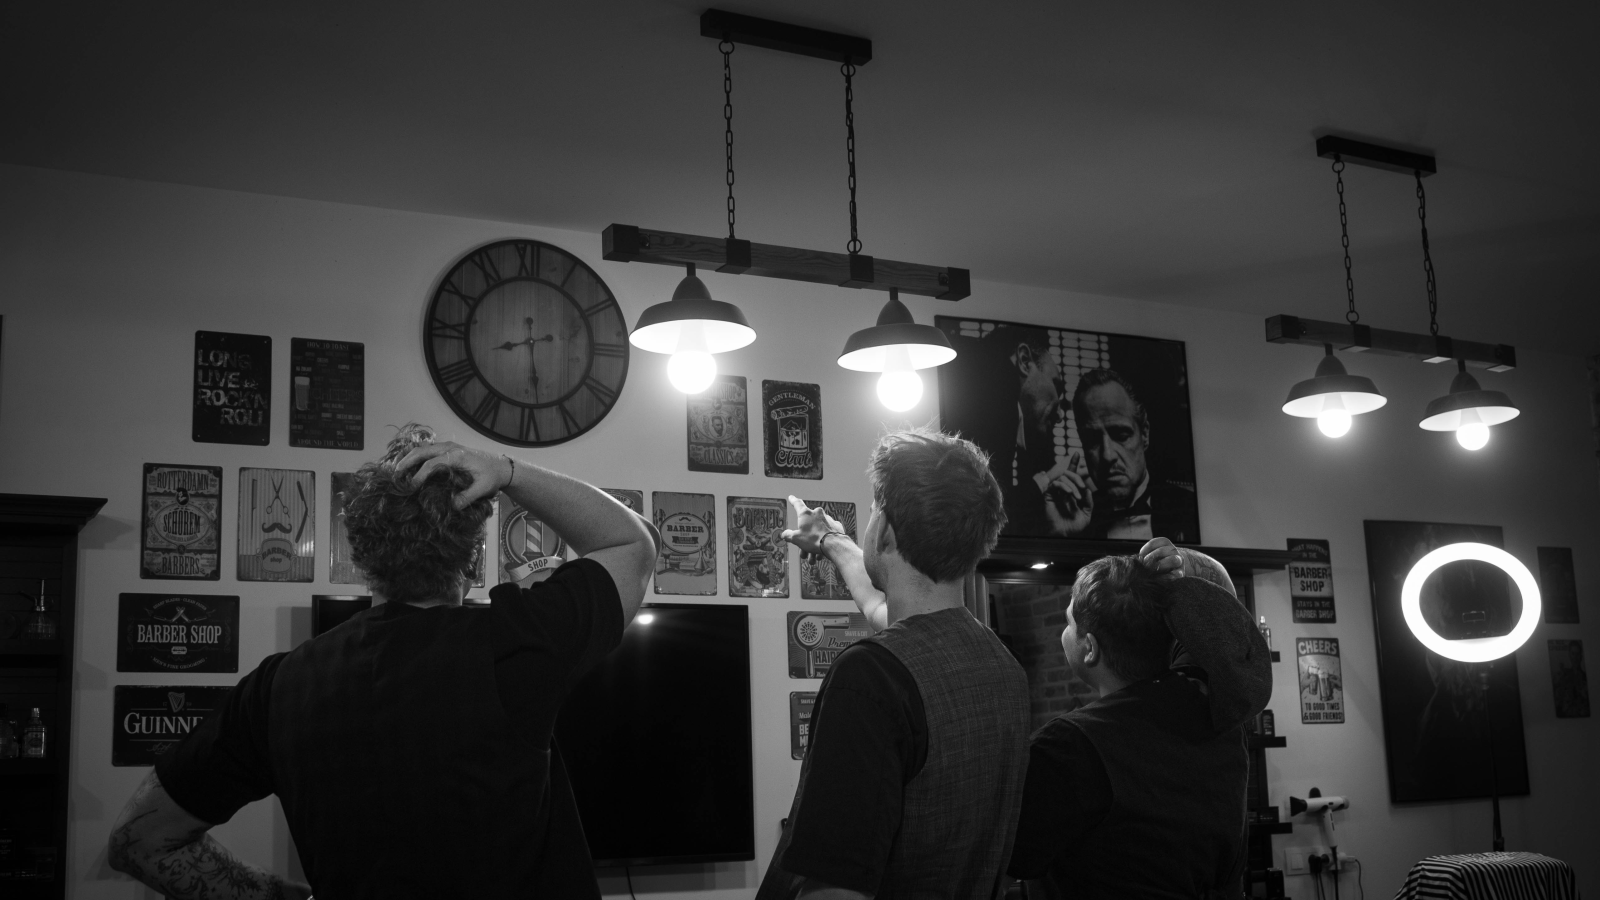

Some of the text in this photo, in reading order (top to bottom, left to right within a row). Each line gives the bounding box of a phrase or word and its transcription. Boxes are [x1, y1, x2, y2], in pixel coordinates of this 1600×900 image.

[515, 243, 541, 277] XII
[197, 349, 253, 370] LONG
[197, 369, 241, 388] LIVE
[768, 391, 816, 410] GENTLEMAN
[220, 407, 264, 427] ROLL
[704, 448, 735, 465] CLASSICS
[775, 449, 814, 469] Club
[666, 524, 704, 533] BARBER
[262, 547, 292, 560] BARBER
[162, 556, 200, 575] BARBERS
[528, 558, 548, 572] SHOP
[1293, 567, 1328, 579] BARBER
[1300, 580, 1325, 592] SHOP
[137, 624, 222, 644] BARBER SHOP
[828, 636, 856, 648] Premi
[1298, 640, 1338, 655] CHEERS
[815, 650, 839, 664] HAIR
[123, 711, 204, 735] GUINN
